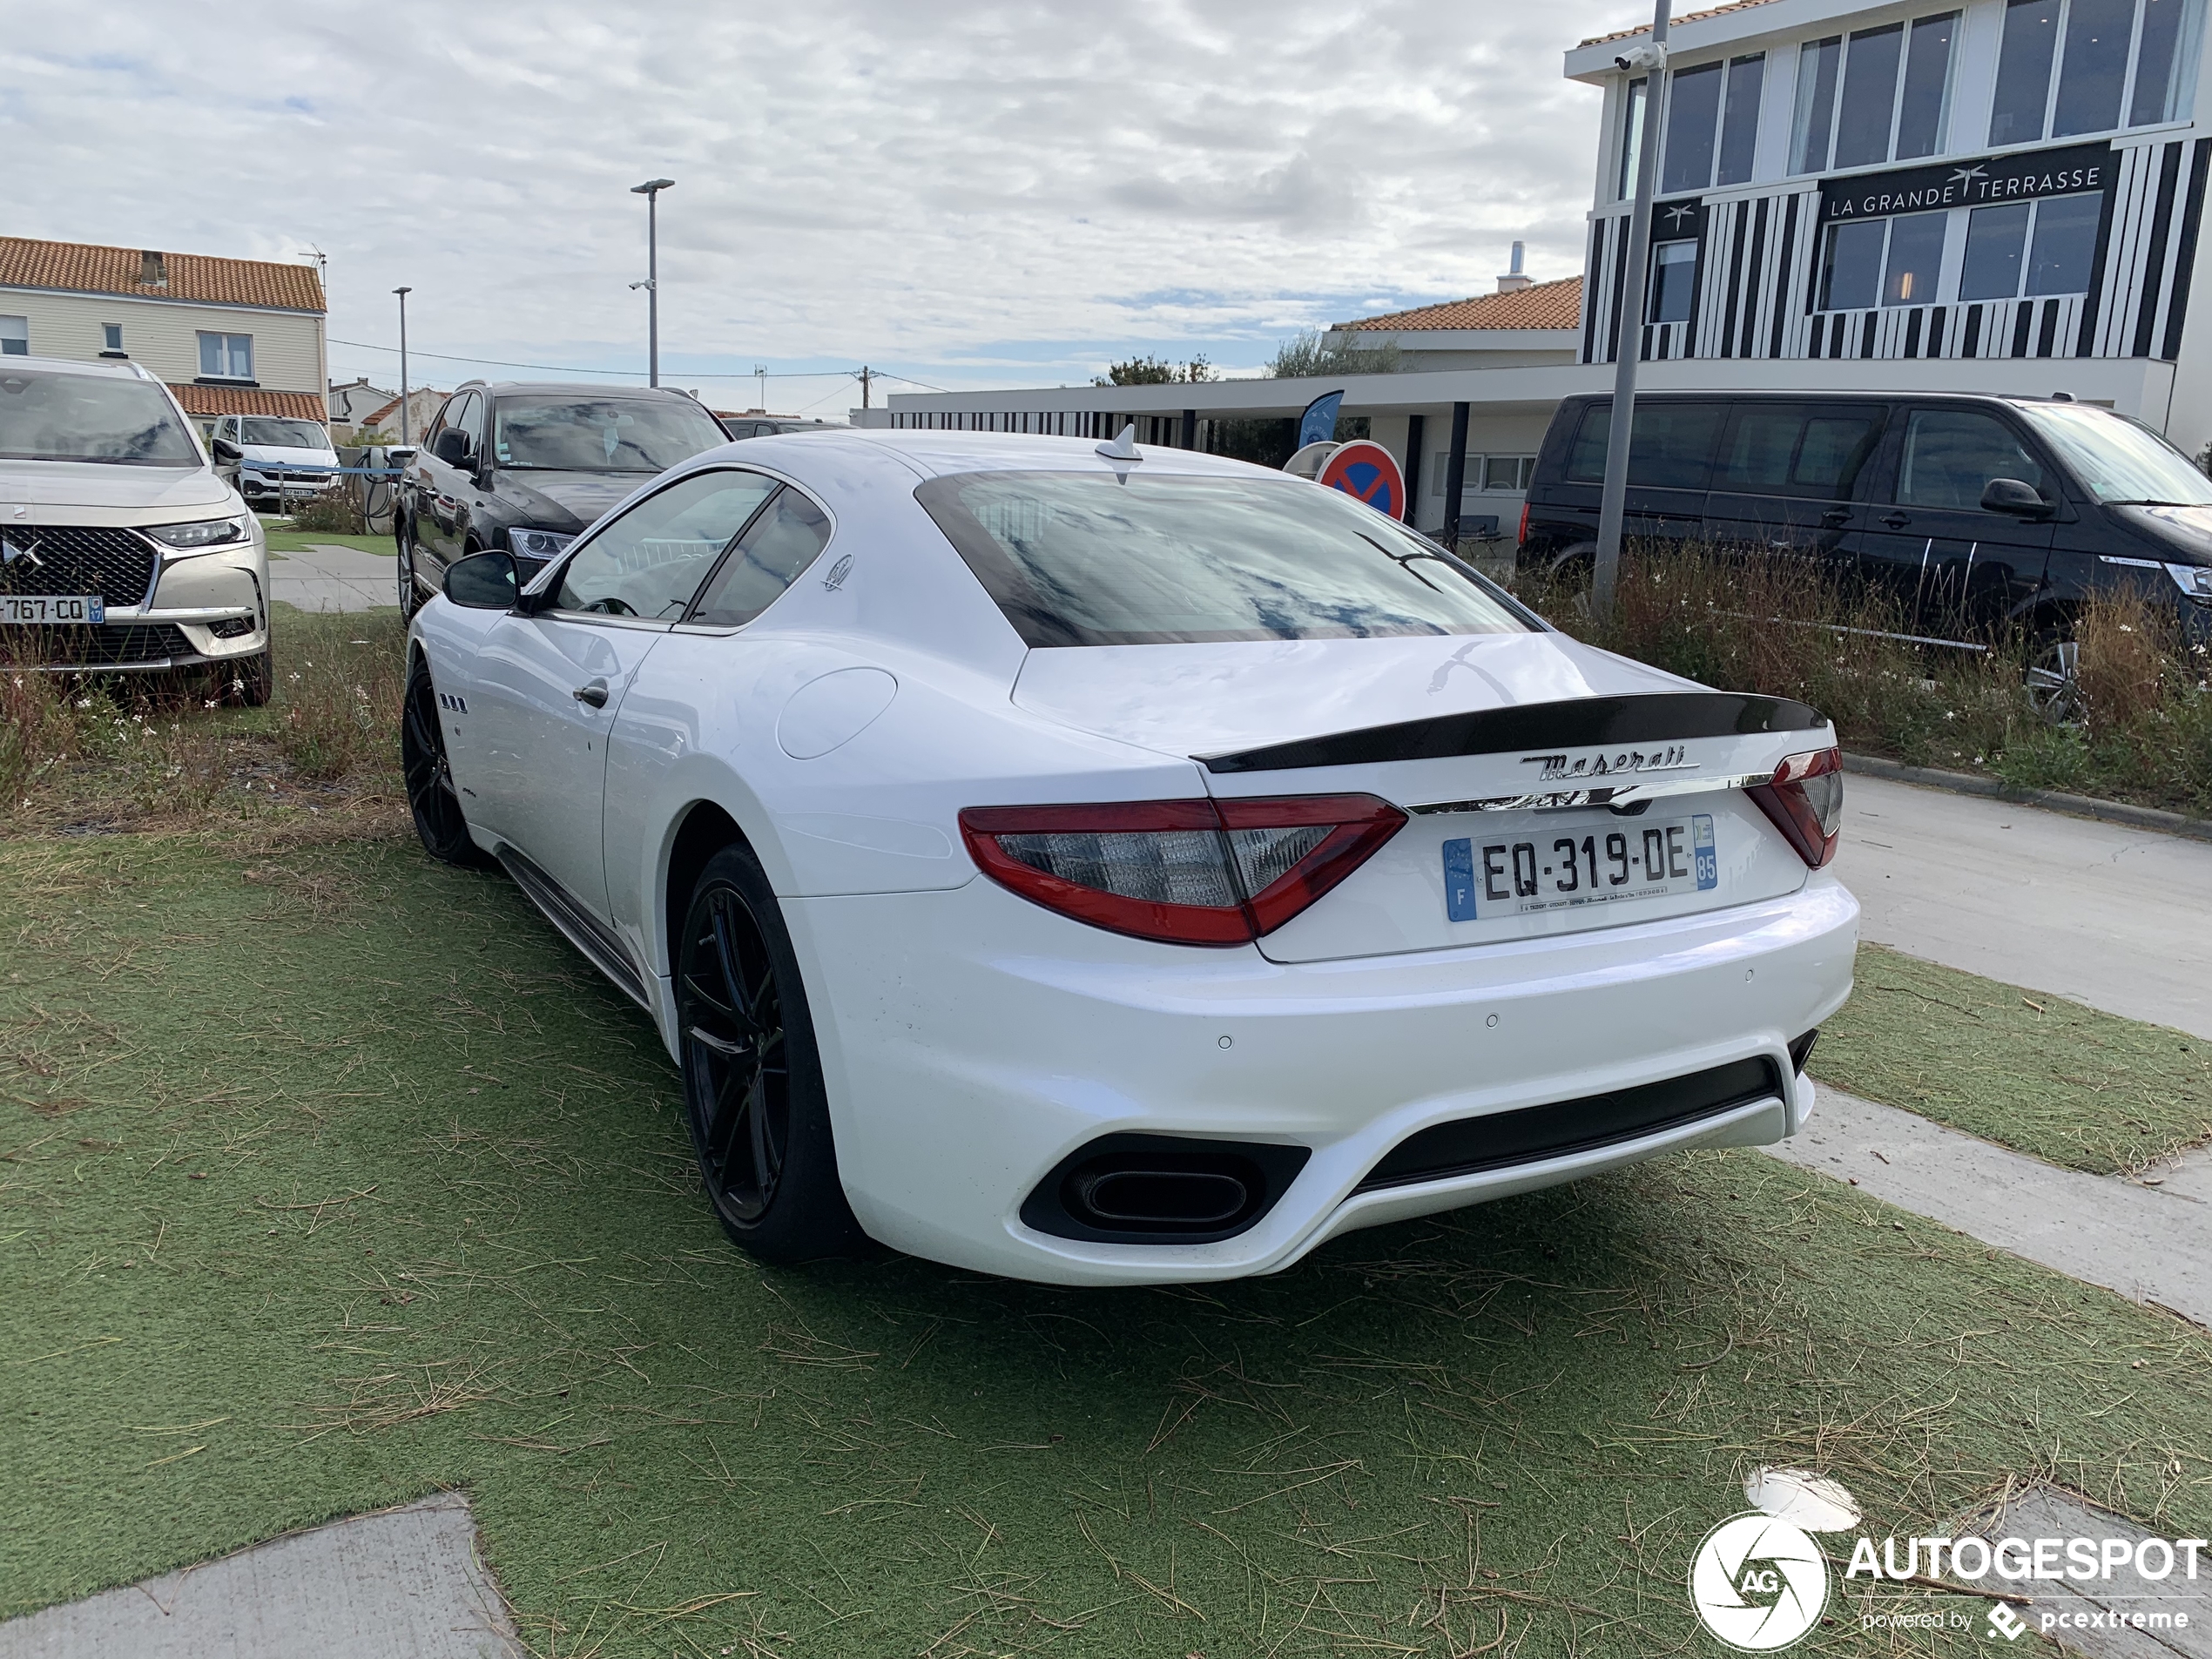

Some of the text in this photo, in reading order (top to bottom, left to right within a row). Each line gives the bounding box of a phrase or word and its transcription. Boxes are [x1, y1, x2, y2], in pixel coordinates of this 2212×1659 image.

[1831, 166, 2101, 216] LA GRANDE TERRASSE
[90, 610, 101, 620] 17
[1520, 745, 1701, 781] Maserati
[1482, 826, 1688, 901] EQ-319-DE
[1696, 854, 1716, 881] 85
[1456, 887, 1466, 906] F
